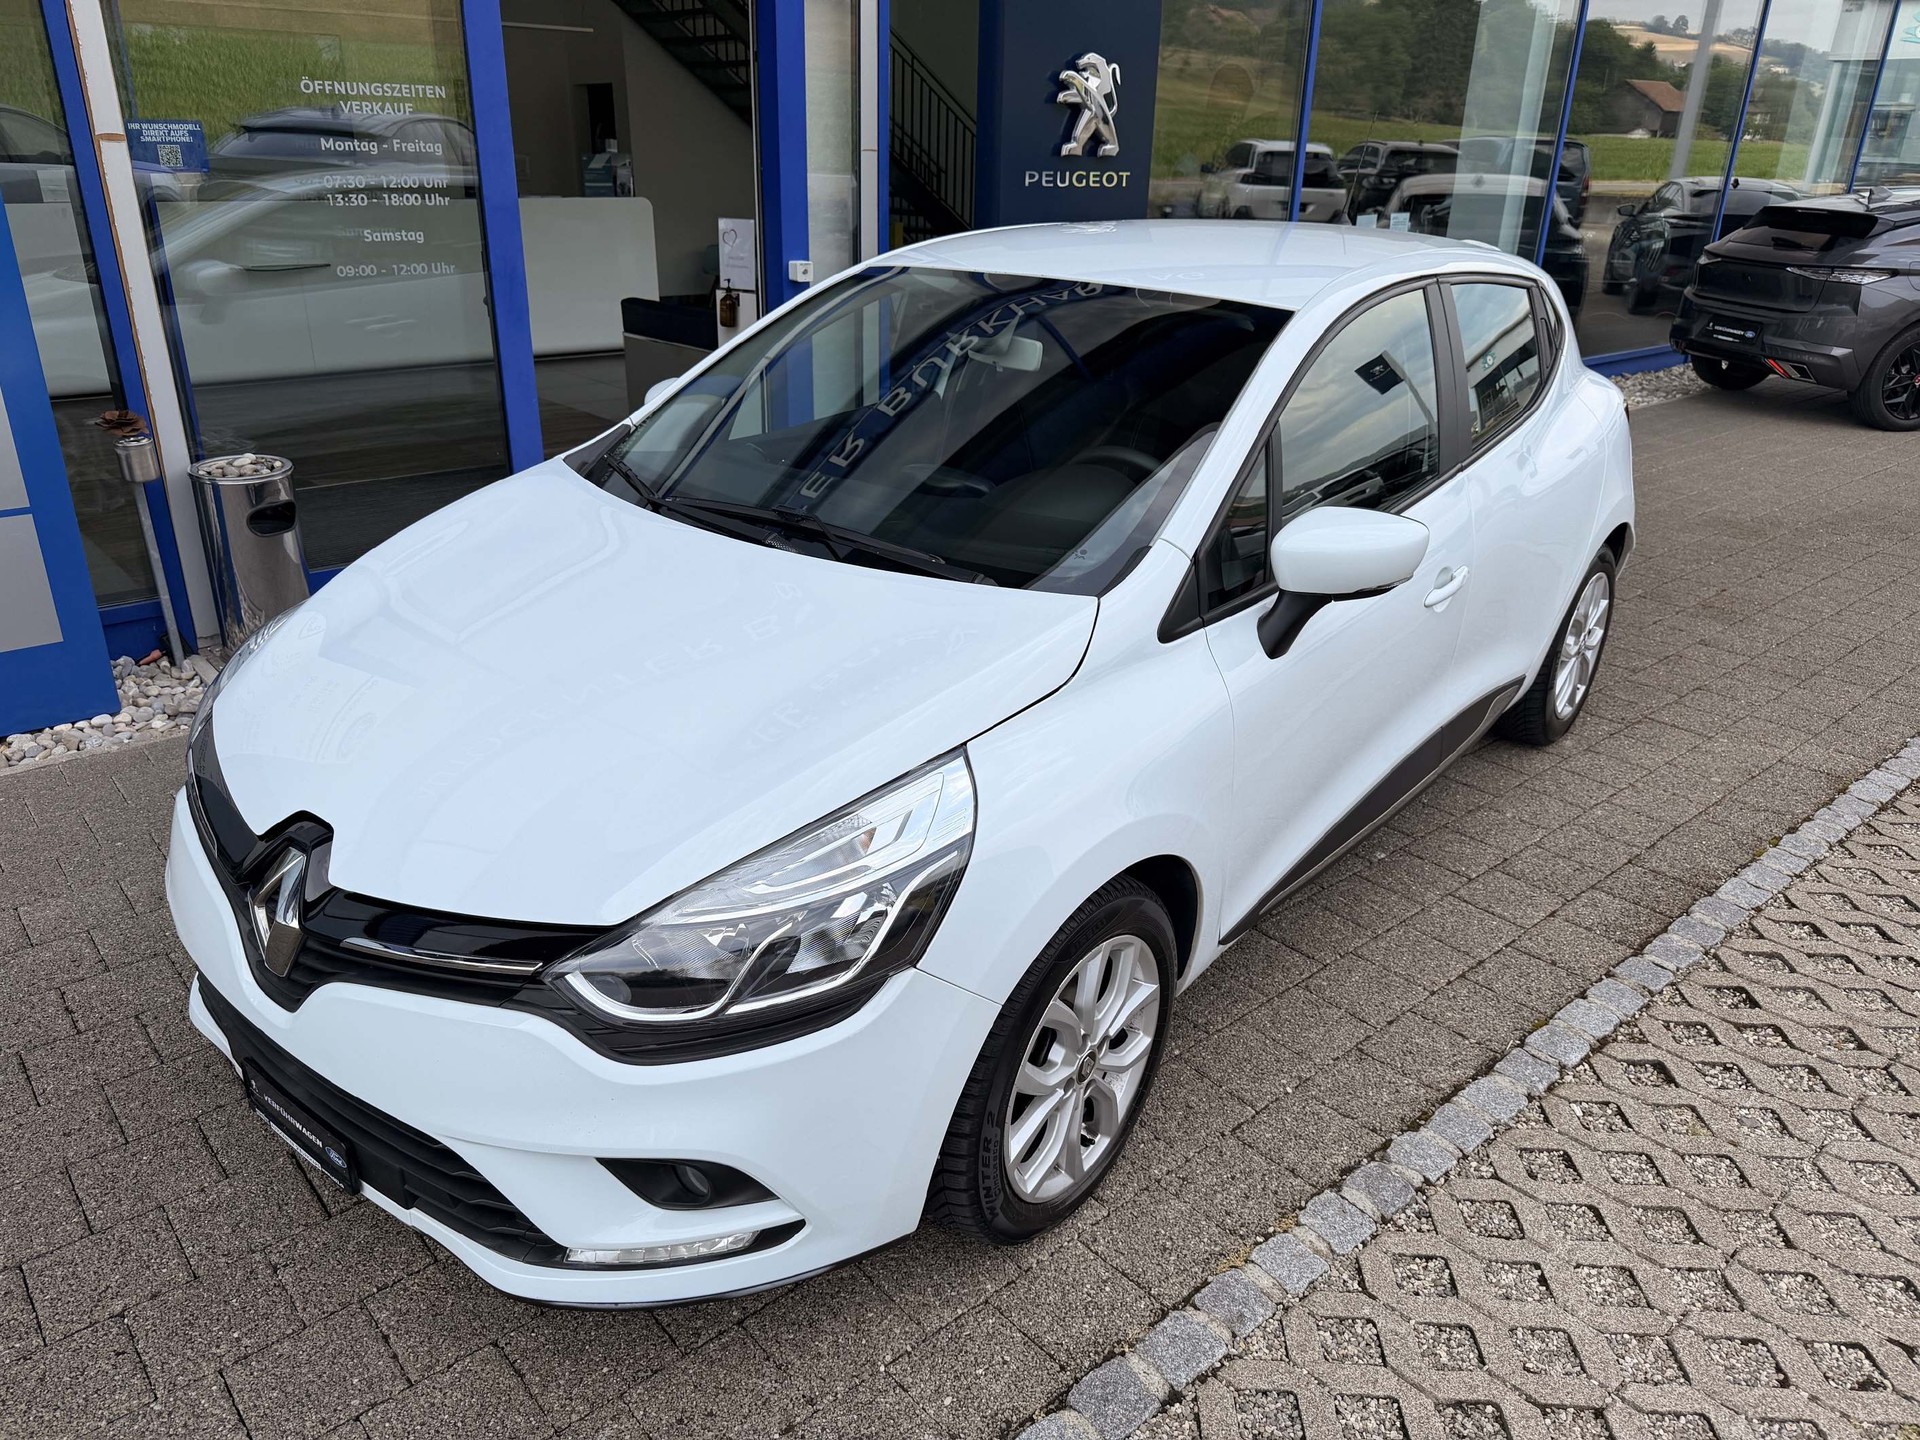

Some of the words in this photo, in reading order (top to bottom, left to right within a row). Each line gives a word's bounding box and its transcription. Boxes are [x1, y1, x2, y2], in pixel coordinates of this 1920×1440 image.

[300, 76, 446, 98] ÖFFNUNGSZEITEN
[340, 101, 413, 115] VERKAUF
[141, 123, 201, 131] WUNSCHMODELL
[320, 138, 378, 155] Montag
[393, 139, 442, 155] Freitag
[324, 176, 365, 188] 07:30
[382, 176, 419, 188] 12:00
[424, 175, 448, 188] Uhr
[1025, 171, 1130, 187] PEUGEOT
[327, 194, 368, 206] 13:30
[383, 194, 421, 206] 18:00
[425, 193, 450, 205] Uhr
[363, 230, 424, 243] Samstag
[337, 265, 377, 277] 09:00
[392, 263, 428, 275] 12:00
[432, 262, 455, 274] Uhr
[987, 1110, 995, 1128] 2
[981, 1136, 999, 1220] WINTER
